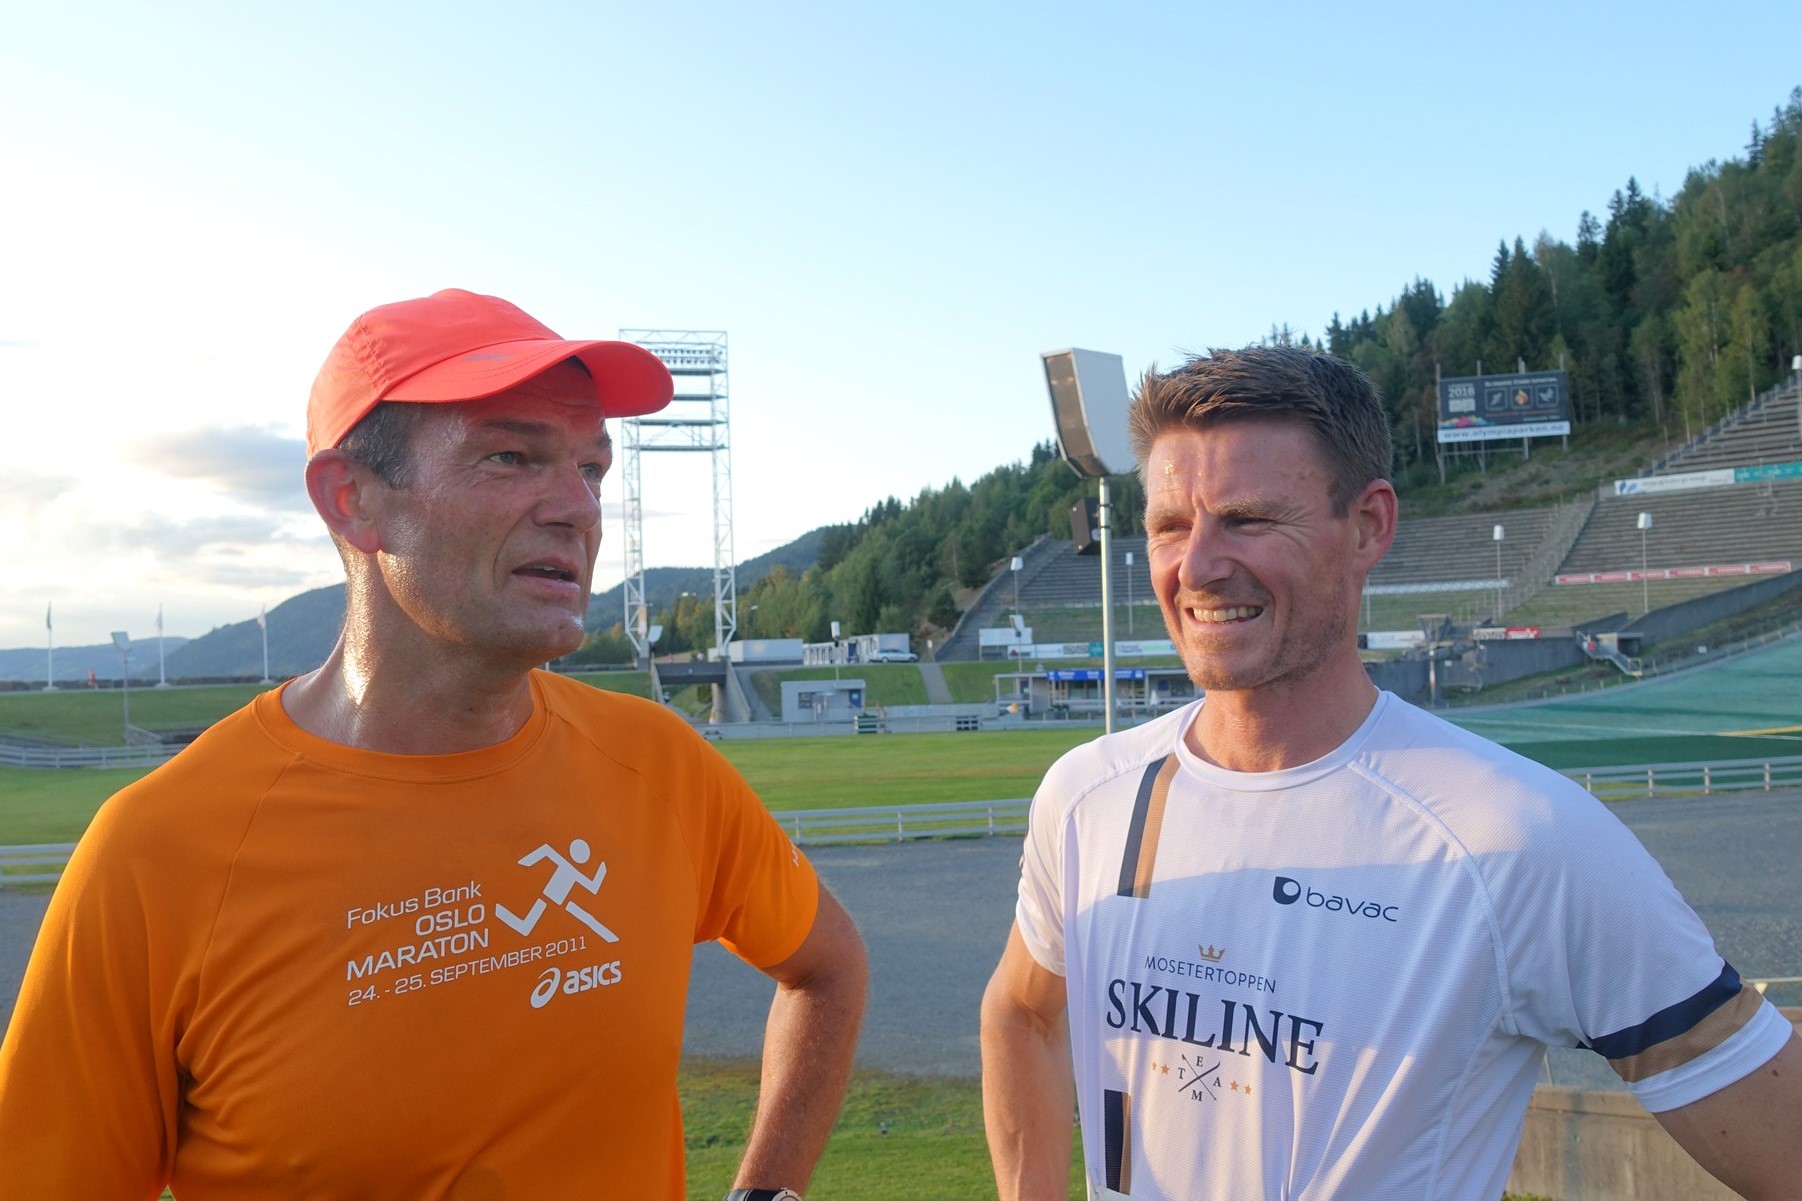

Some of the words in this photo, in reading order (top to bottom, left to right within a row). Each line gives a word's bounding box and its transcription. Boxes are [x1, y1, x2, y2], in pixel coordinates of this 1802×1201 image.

[347, 897, 418, 929] Fokus
[424, 881, 482, 909] Bank
[415, 904, 486, 936] OSLO
[1306, 886, 1399, 922] bavac
[346, 928, 489, 981] MARATON
[348, 984, 381, 1006] 24.
[395, 974, 427, 994] 25.
[430, 945, 543, 985] SEPTEMBER
[545, 936, 587, 957] 2011
[1145, 955, 1277, 994] MOSETERTOPPEN
[1106, 978, 1325, 1076] SKILINE
